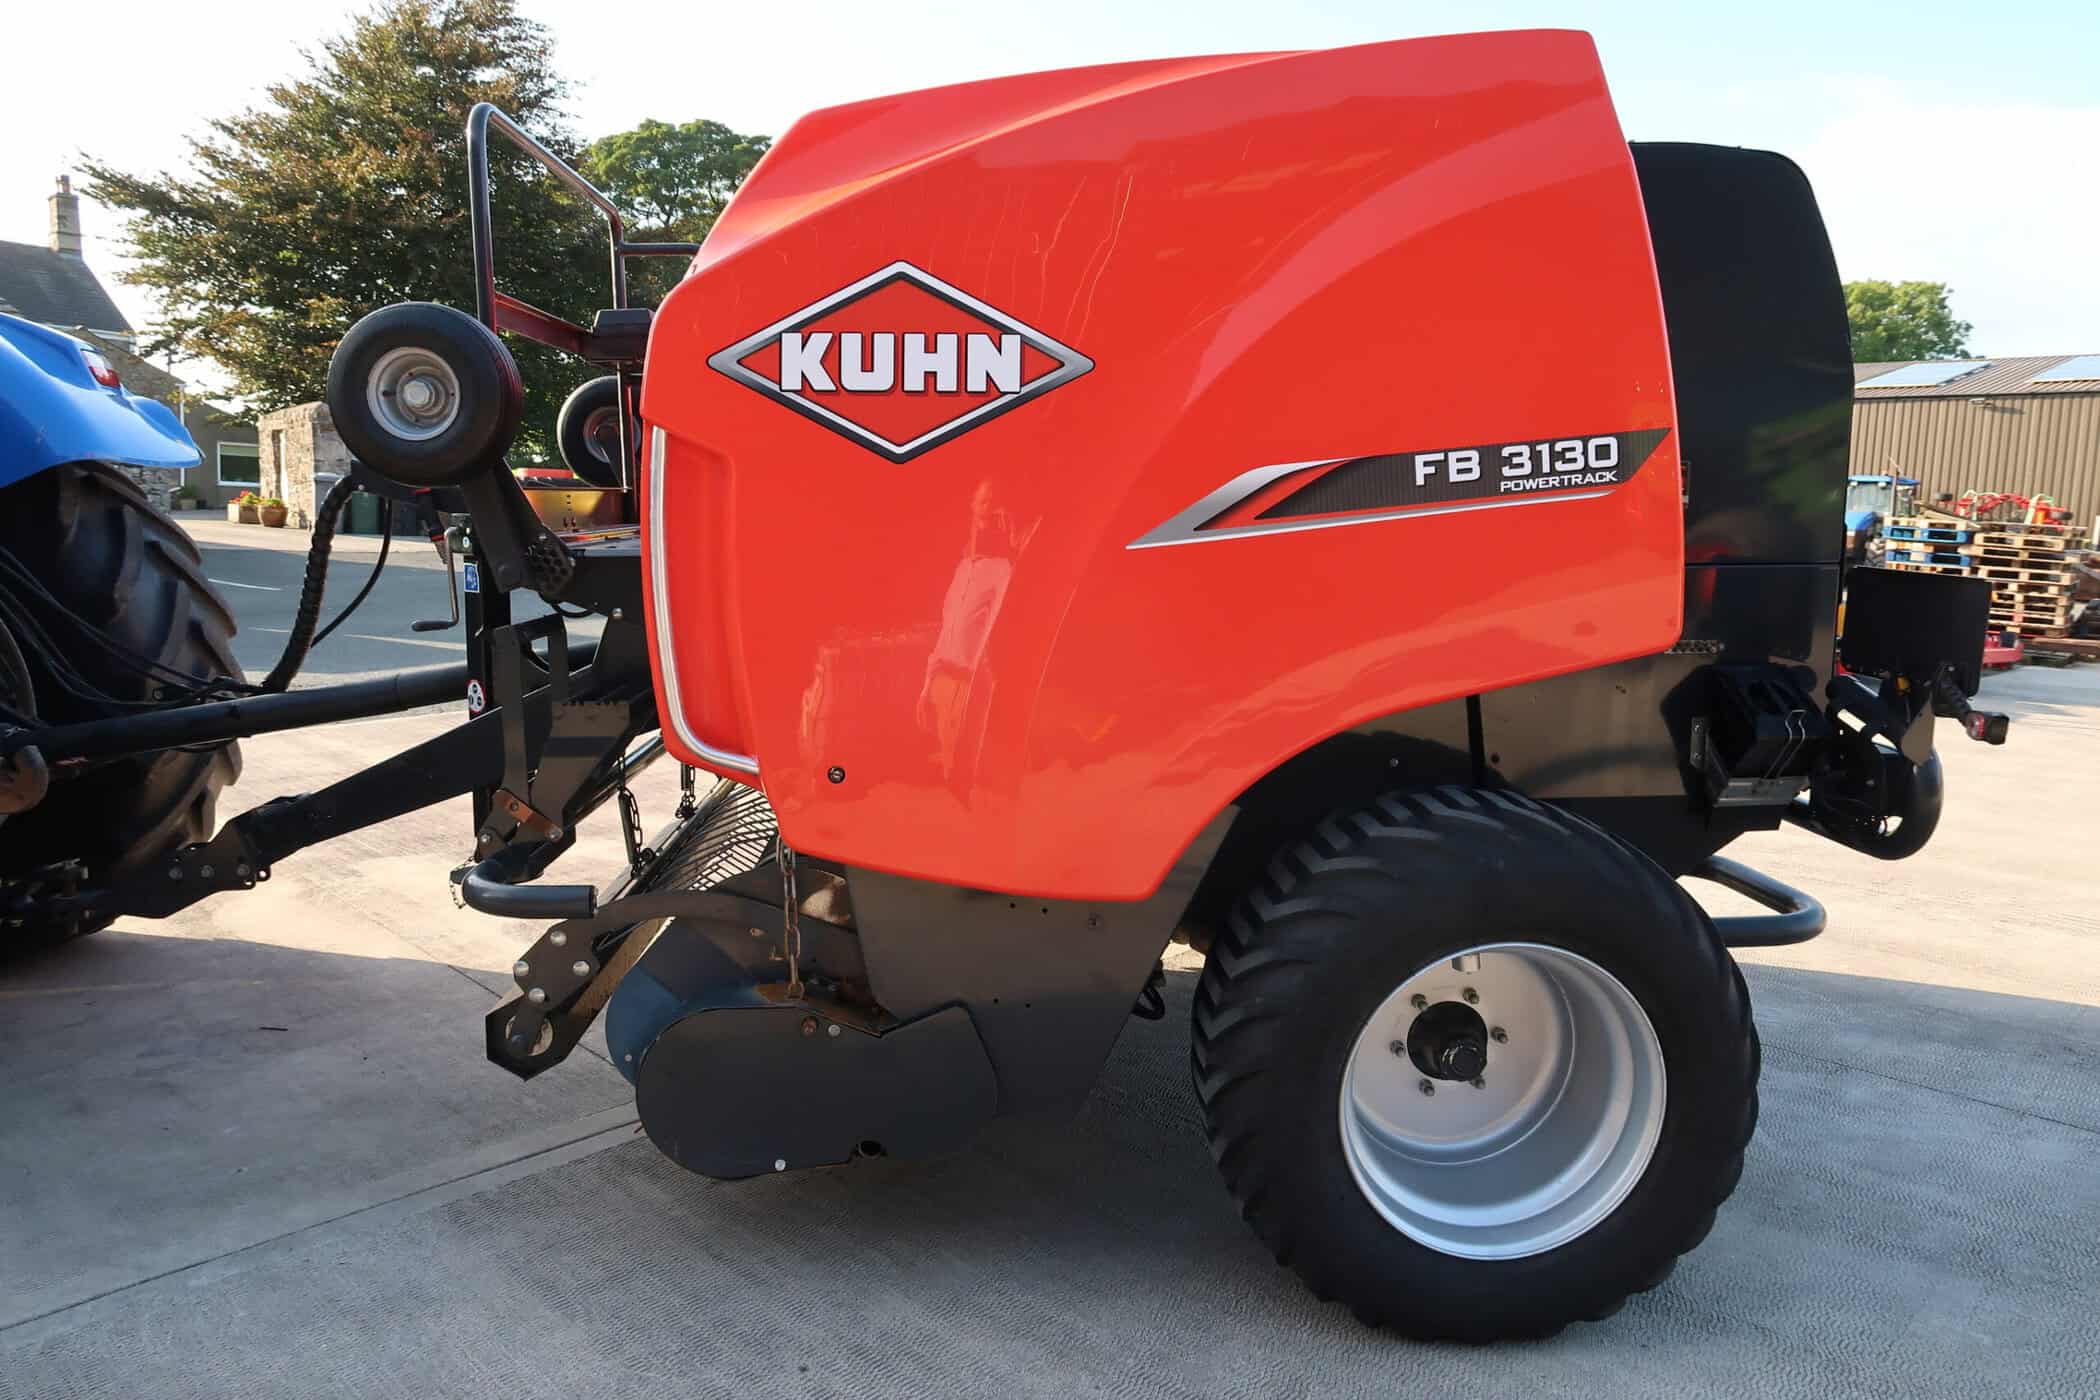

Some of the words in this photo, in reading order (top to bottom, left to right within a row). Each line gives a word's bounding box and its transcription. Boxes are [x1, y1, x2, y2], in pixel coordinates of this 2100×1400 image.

[780, 332, 1022, 393] KUHN
[1415, 450, 1481, 486] FB
[1501, 436, 1618, 477] 3130
[1501, 470, 1617, 492] POWERTRACK
